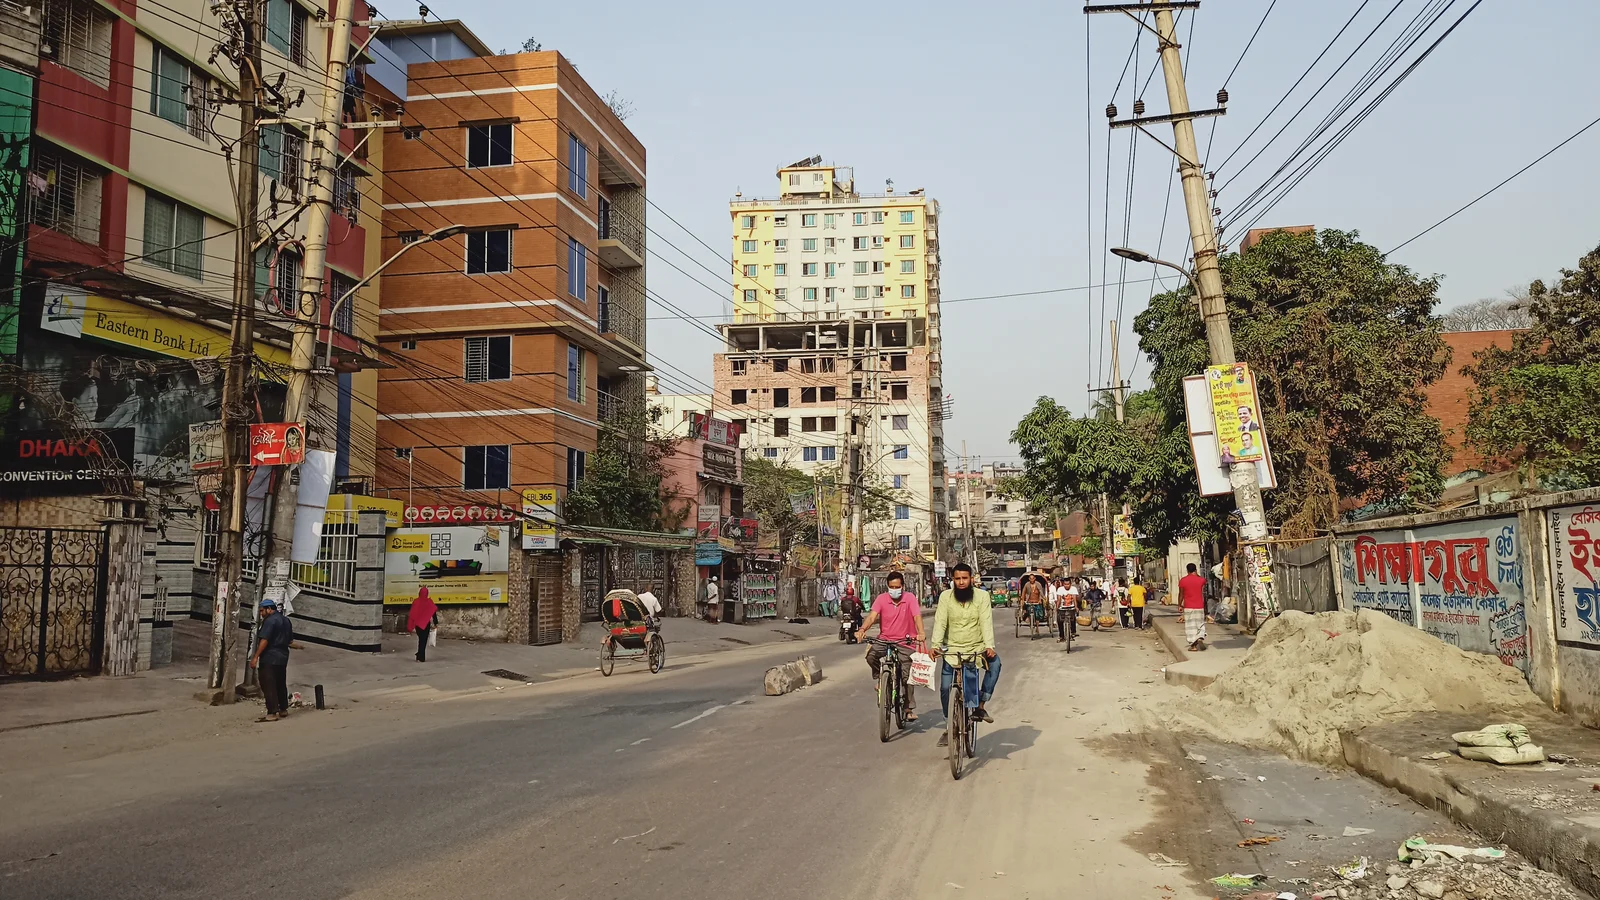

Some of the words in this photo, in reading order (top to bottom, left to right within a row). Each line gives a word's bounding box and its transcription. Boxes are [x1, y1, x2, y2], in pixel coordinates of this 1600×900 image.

[95, 311, 149, 341] Eastern
[152, 327, 186, 351] Bank
[19, 438, 104, 459] DHAKA
[0, 469, 74, 482] ONVENTION
[526, 493, 538, 501] EBL
[538, 493, 552, 501] 365
[1495, 525, 1515, 558] ভর্তি
[1354, 535, 1499, 597] শিক্ষাগুরু
